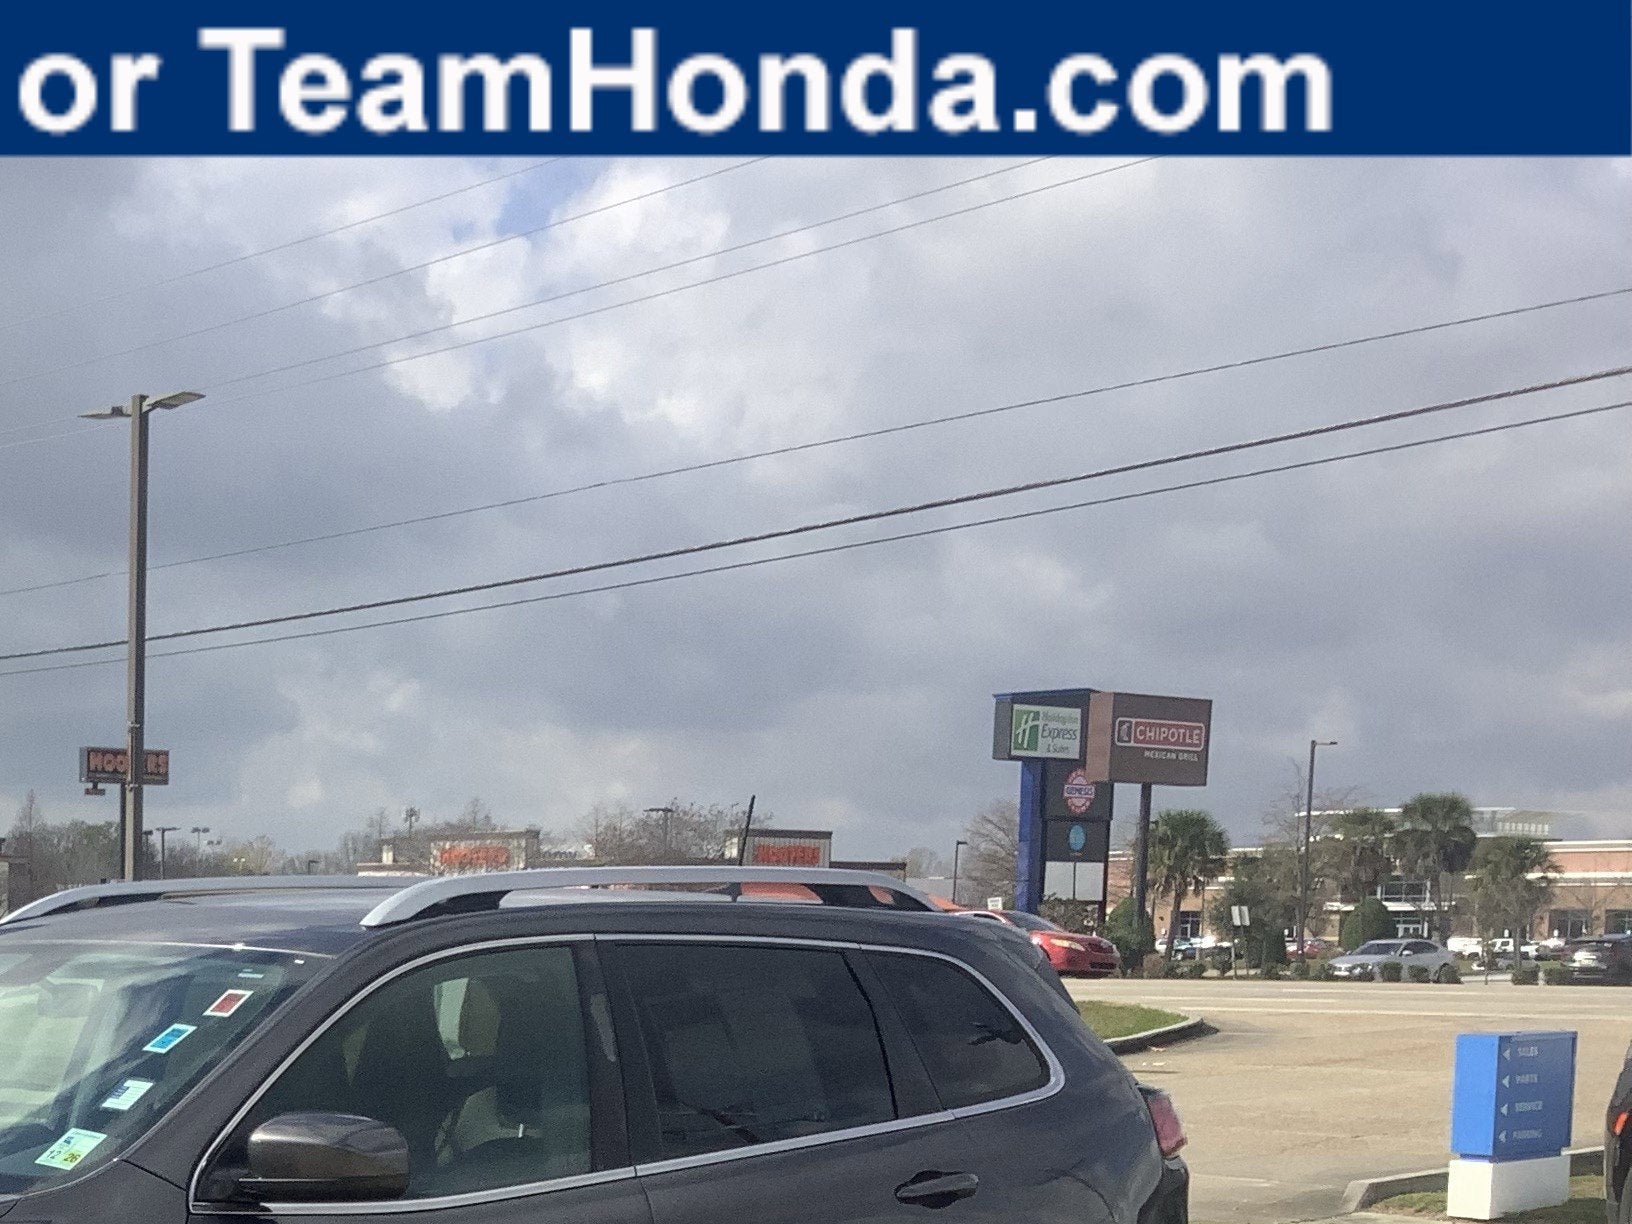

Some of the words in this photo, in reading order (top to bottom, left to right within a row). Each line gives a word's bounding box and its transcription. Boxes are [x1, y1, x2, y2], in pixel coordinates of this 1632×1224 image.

[1041, 723, 1078, 743] Express
[1136, 725, 1200, 744] CHIPOTLE
[89, 751, 168, 774] HOORS
[1144, 750, 1177, 760] MEXICAN
